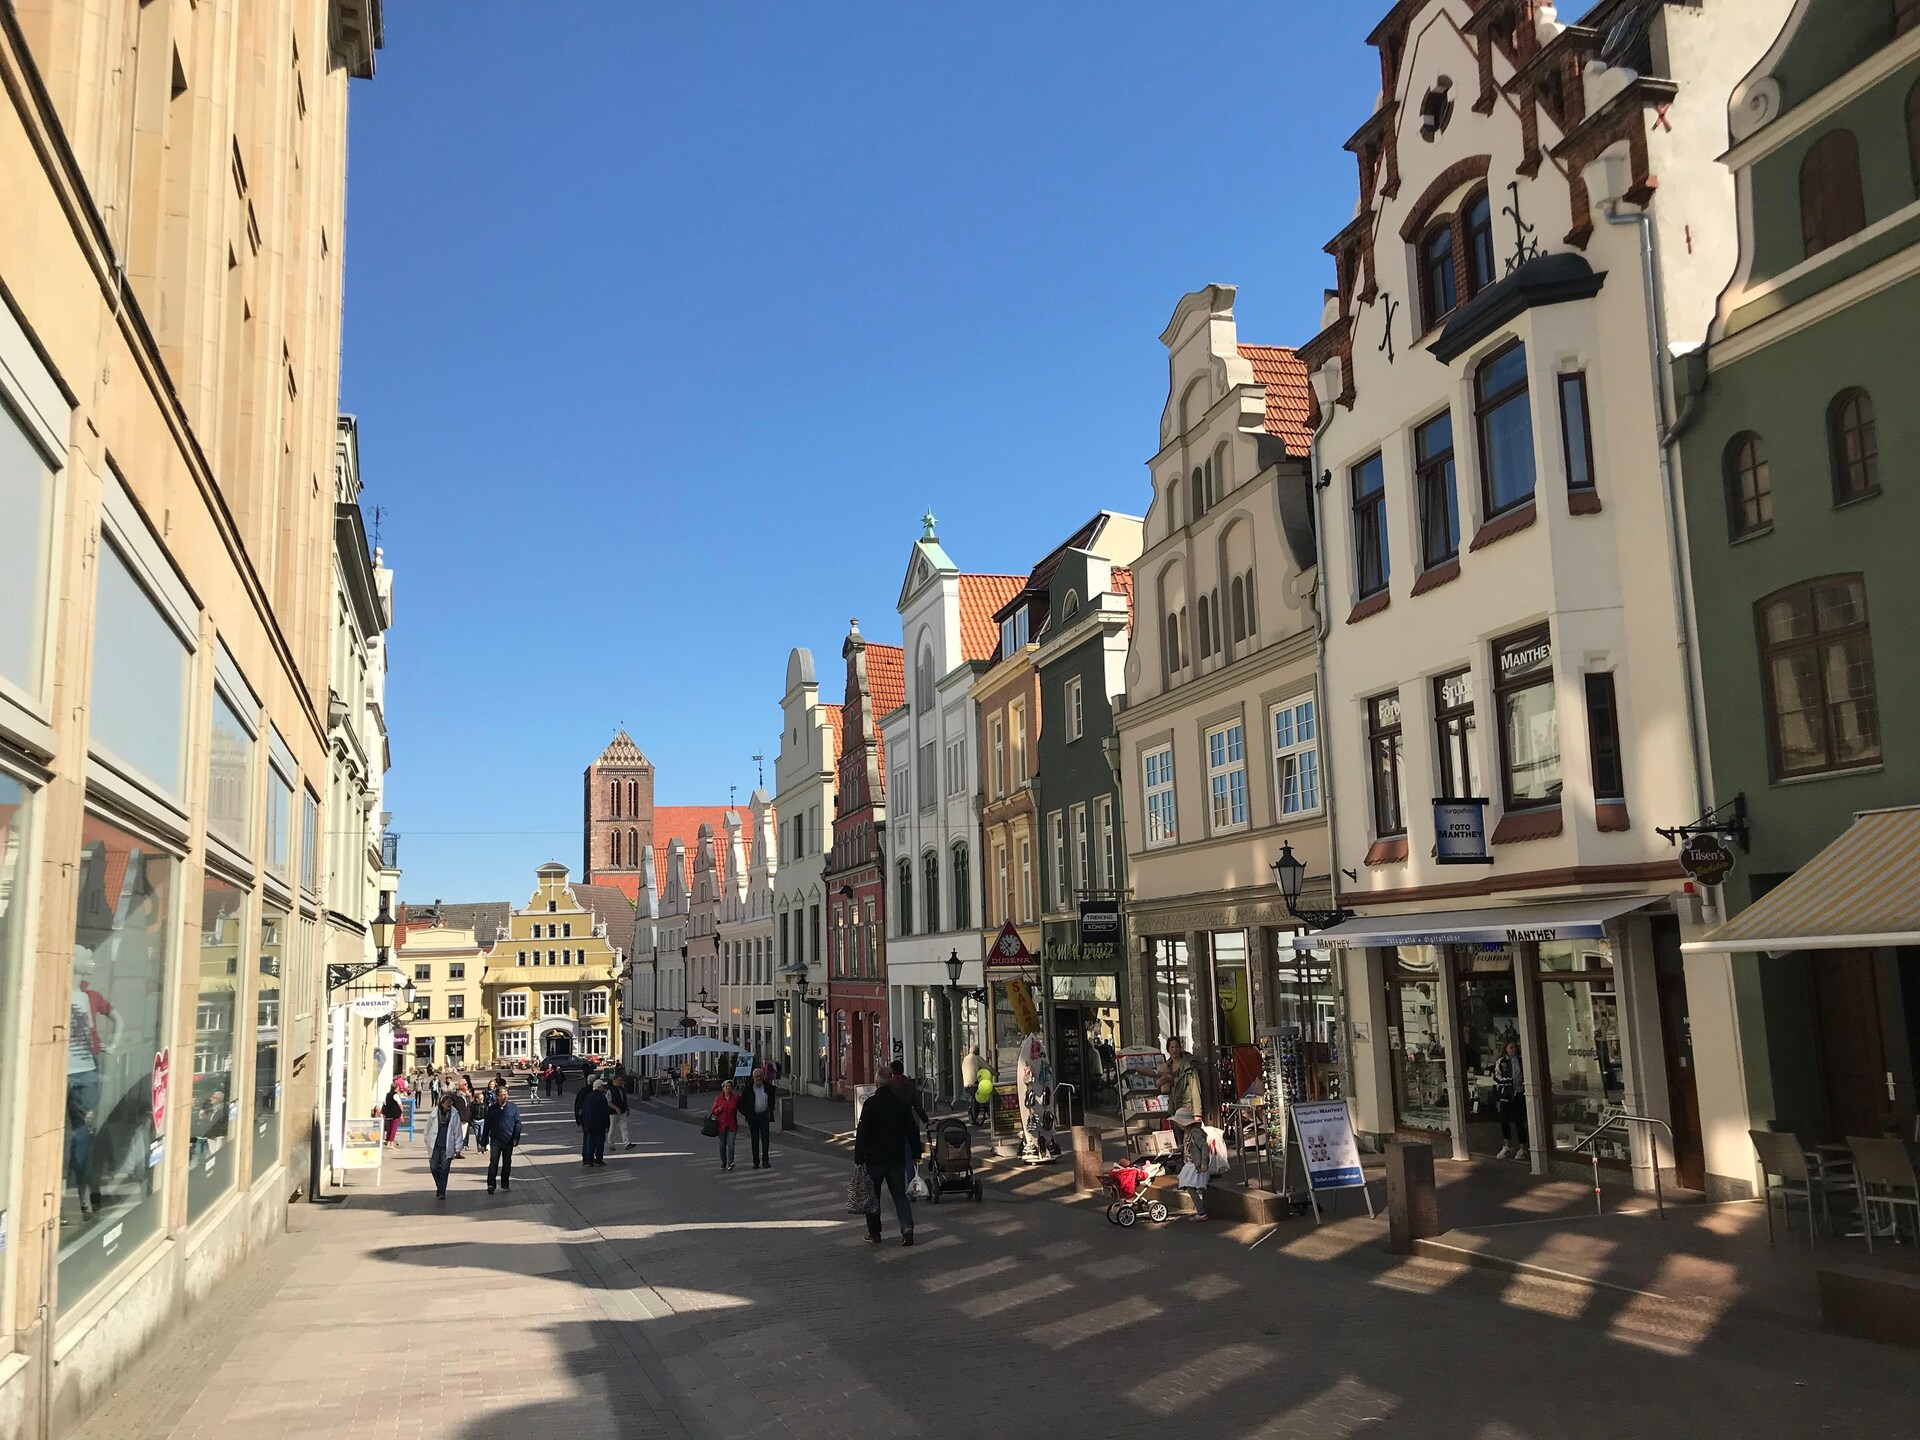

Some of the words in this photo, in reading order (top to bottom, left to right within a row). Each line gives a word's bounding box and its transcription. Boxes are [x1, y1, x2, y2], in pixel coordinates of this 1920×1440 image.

[1501, 644, 1551, 671] MANTHEY
[1439, 831, 1483, 839] MANTHEY
[1689, 849, 1726, 861] Tilsen's
[1506, 929, 1556, 941] MANTHEY
[1317, 939, 1350, 949] MANTHEY
